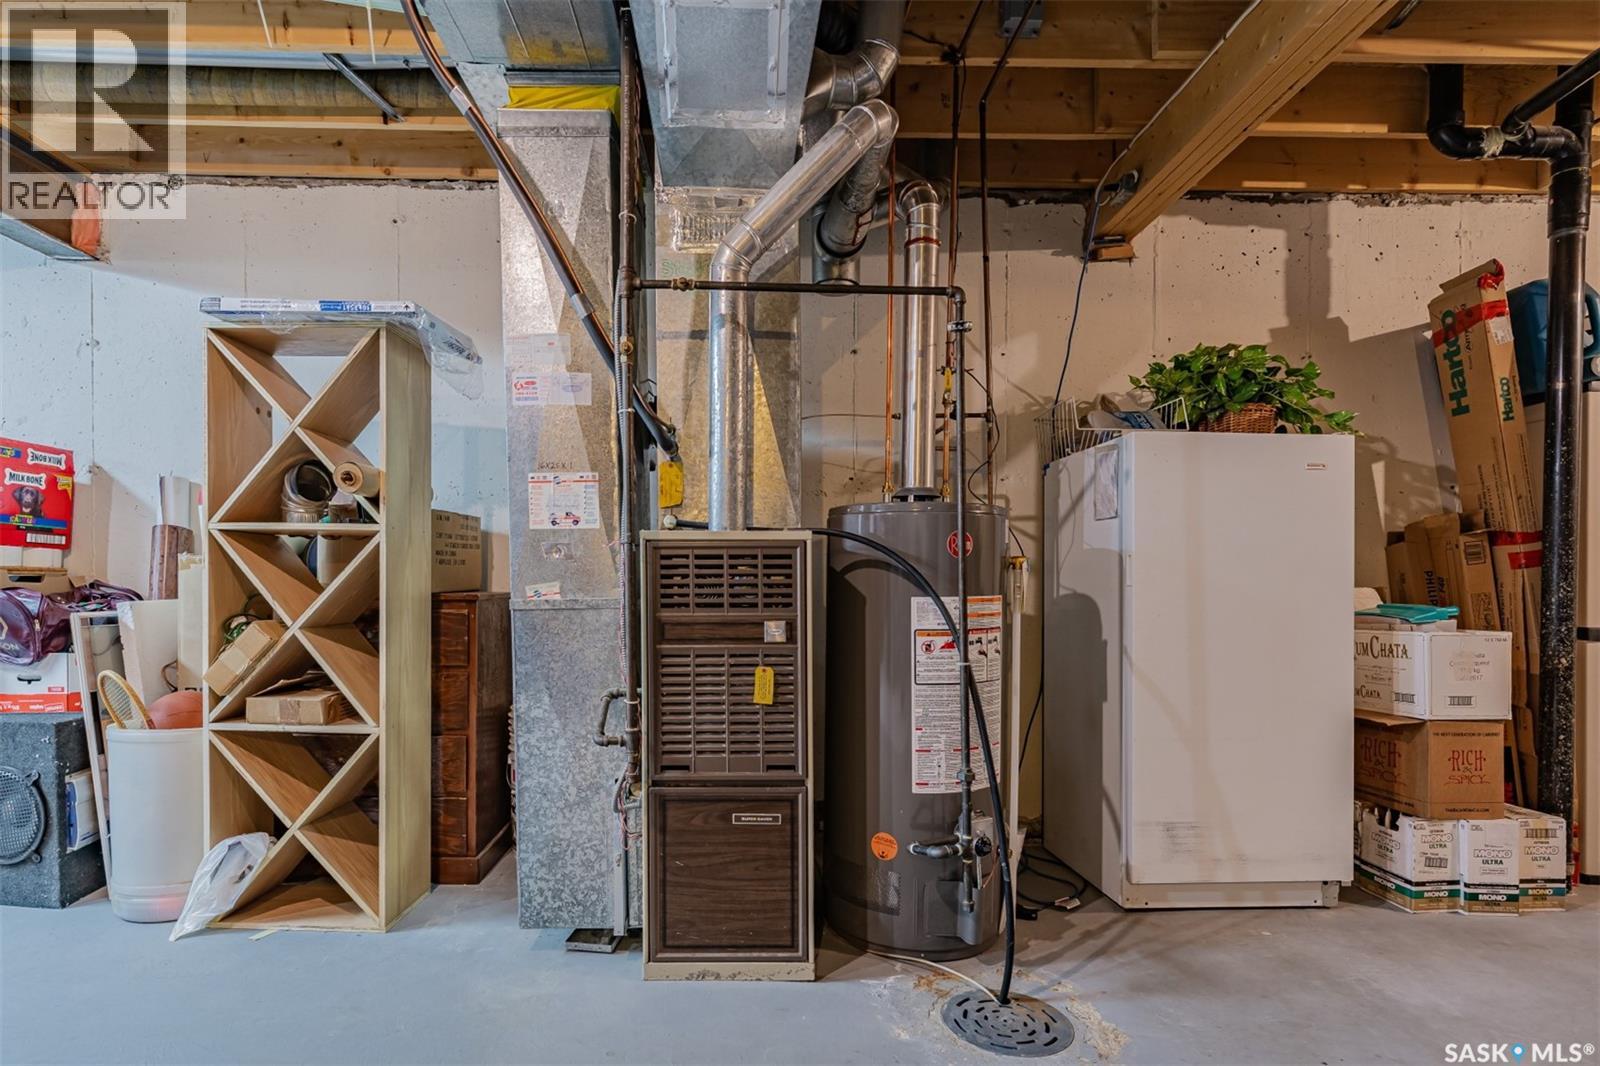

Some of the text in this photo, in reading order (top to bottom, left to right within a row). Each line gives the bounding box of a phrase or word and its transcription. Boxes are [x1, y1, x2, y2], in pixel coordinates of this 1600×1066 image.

[1440, 308, 1470, 416] Hartco
[1498, 377, 1515, 422] Hartco
[30, 451, 63, 467] MILK BONE
[8, 471, 25, 483] MILK
[26, 474, 44, 486] BONE
[1354, 635, 1409, 660] UMCHATA
[1448, 749, 1487, 772] RICH
[1444, 774, 1491, 786] SPICY
[1371, 831, 1400, 850] MONO
[1421, 833, 1454, 843] MONO
[1376, 843, 1394, 854] ULTRA
[1473, 848, 1513, 858] MONO
[1524, 846, 1560, 856] MONO
[1373, 875, 1396, 890] MONO
[1424, 890, 1449, 898] MONO
[1478, 894, 1507, 902] MONO
